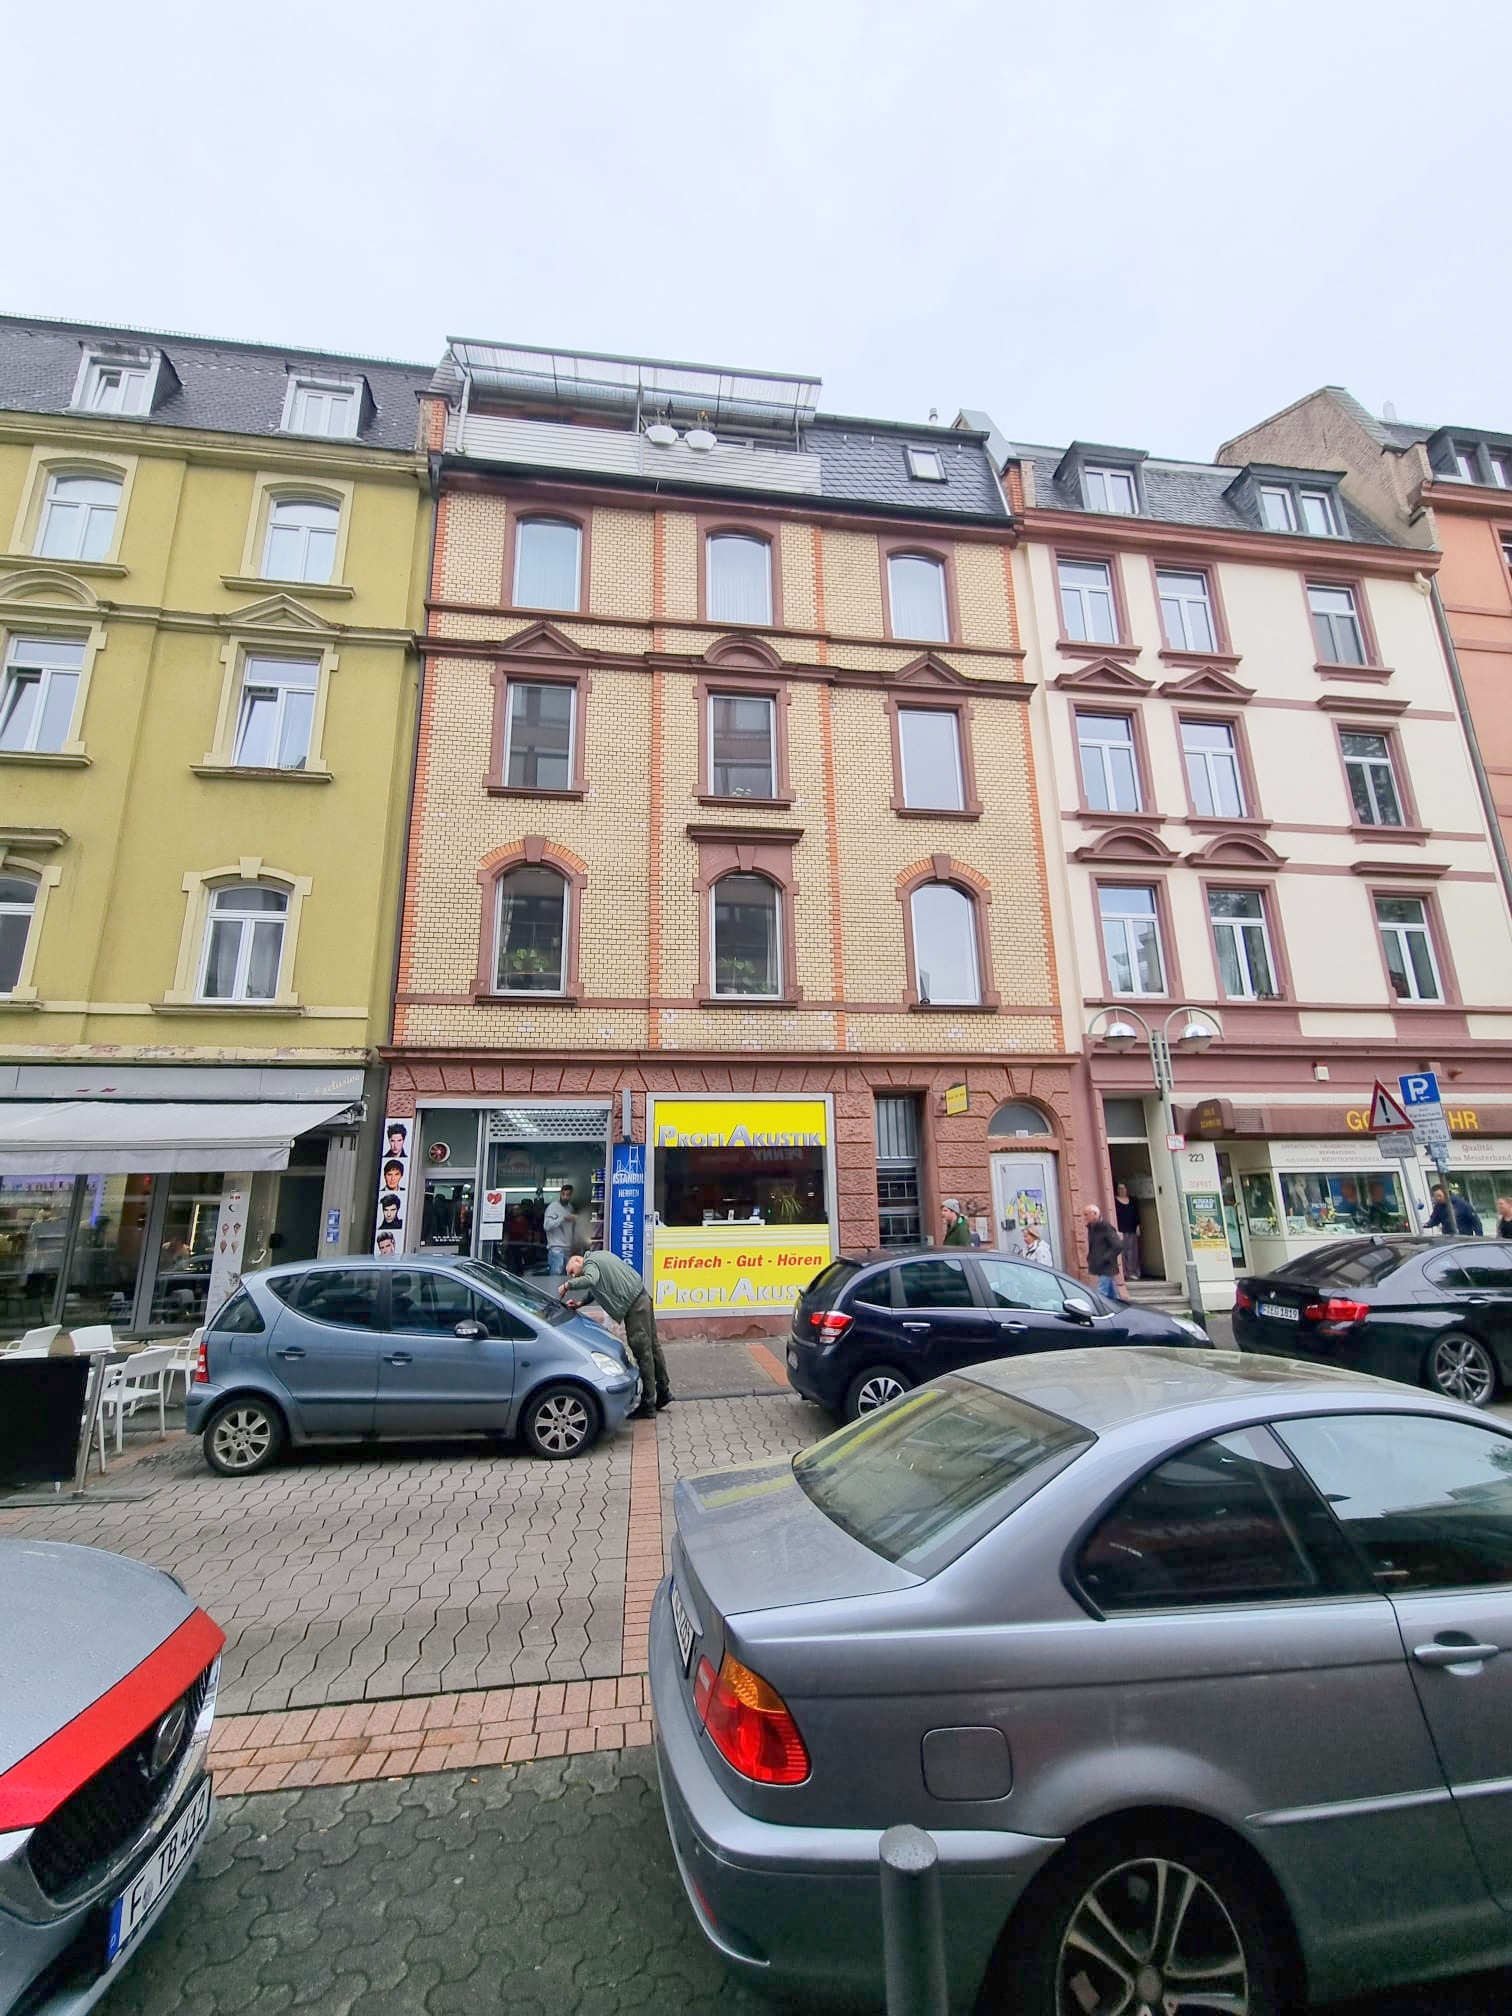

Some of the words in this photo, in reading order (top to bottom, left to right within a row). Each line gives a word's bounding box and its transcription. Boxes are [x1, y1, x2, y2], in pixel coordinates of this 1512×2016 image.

[1407, 1078, 1429, 1101] P
[1445, 1110, 1479, 1130] HR
[1188, 1153, 1205, 1163] 223
[663, 1255, 722, 1270] Einfach
[736, 1253, 764, 1268] Gut
[777, 1252, 823, 1267] Hören
[129, 1874, 146, 1927] F
